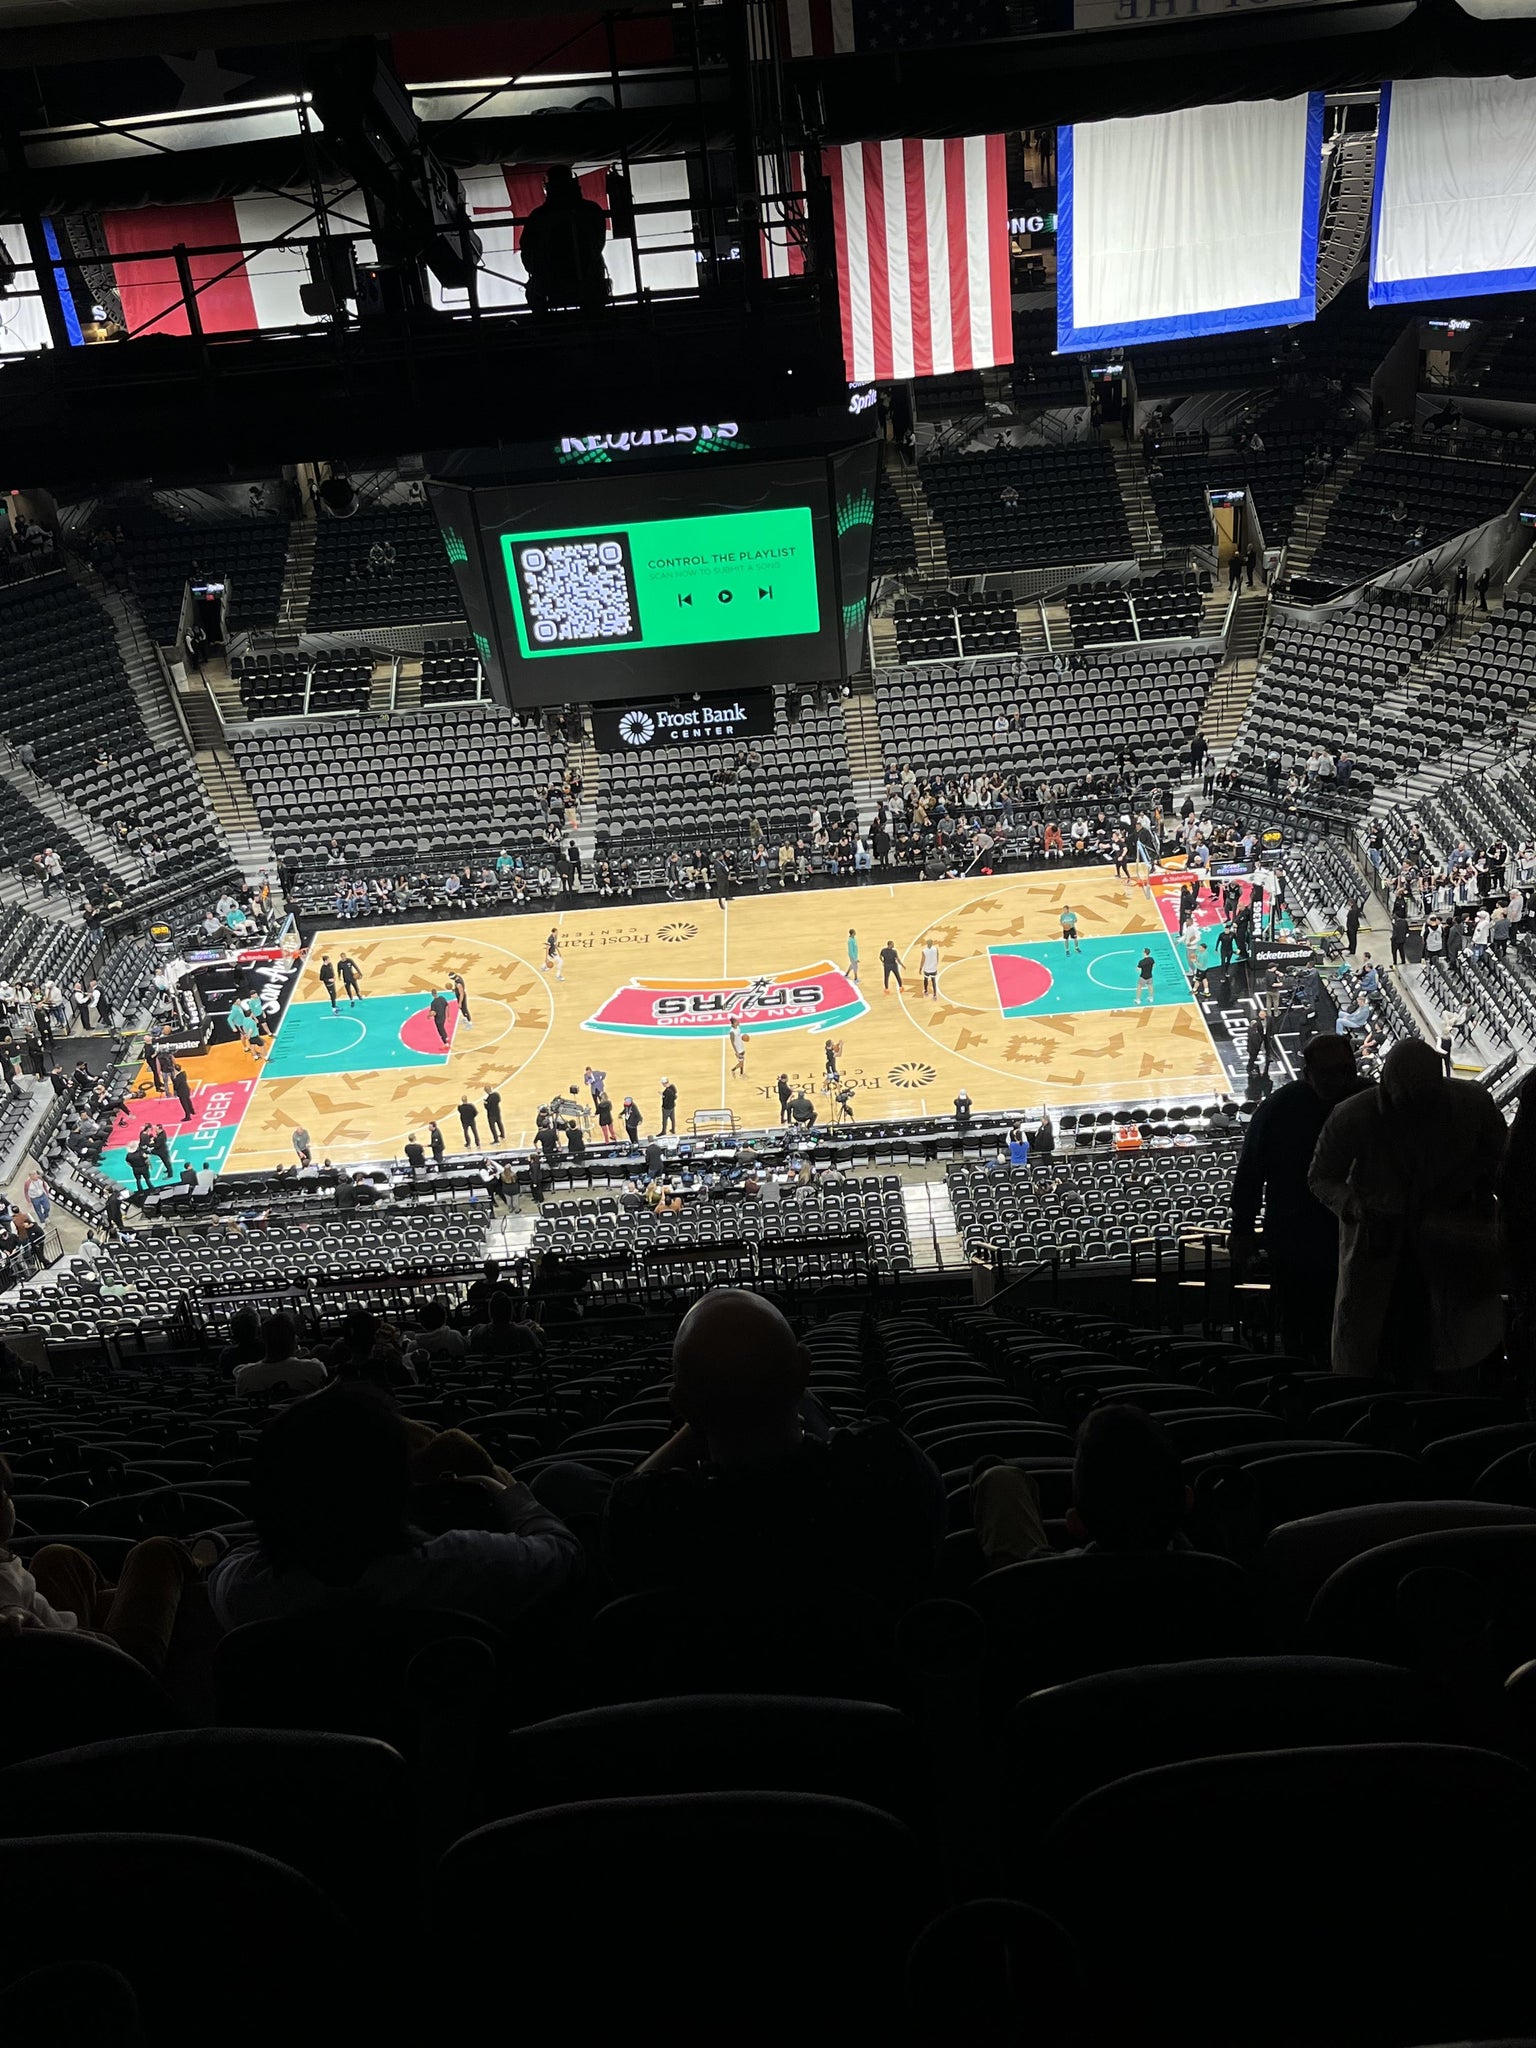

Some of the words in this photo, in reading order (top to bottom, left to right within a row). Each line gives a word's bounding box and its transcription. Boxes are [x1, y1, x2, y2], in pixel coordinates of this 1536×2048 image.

[849, 389, 877, 414] Sprit
[648, 556, 708, 569] CONTROL
[712, 553, 736, 563] THE
[740, 547, 796, 561] PLAYLIST
[656, 710, 700, 728] Frost
[702, 702, 748, 724] Bank
[670, 725, 734, 739] CENTER
[1252, 901, 1262, 937] bet365
[561, 927, 637, 938] CENTER
[600, 934, 650, 946] Frost
[550, 938, 595, 949] Ban
[1256, 950, 1313, 961] ticketmaster
[182, 990, 200, 1024] bet365
[653, 978, 823, 1018] SPURS
[657, 1011, 757, 1025] ANTONIO
[768, 1006, 817, 1017] SAN
[189, 1091, 234, 1150] LEDGER
